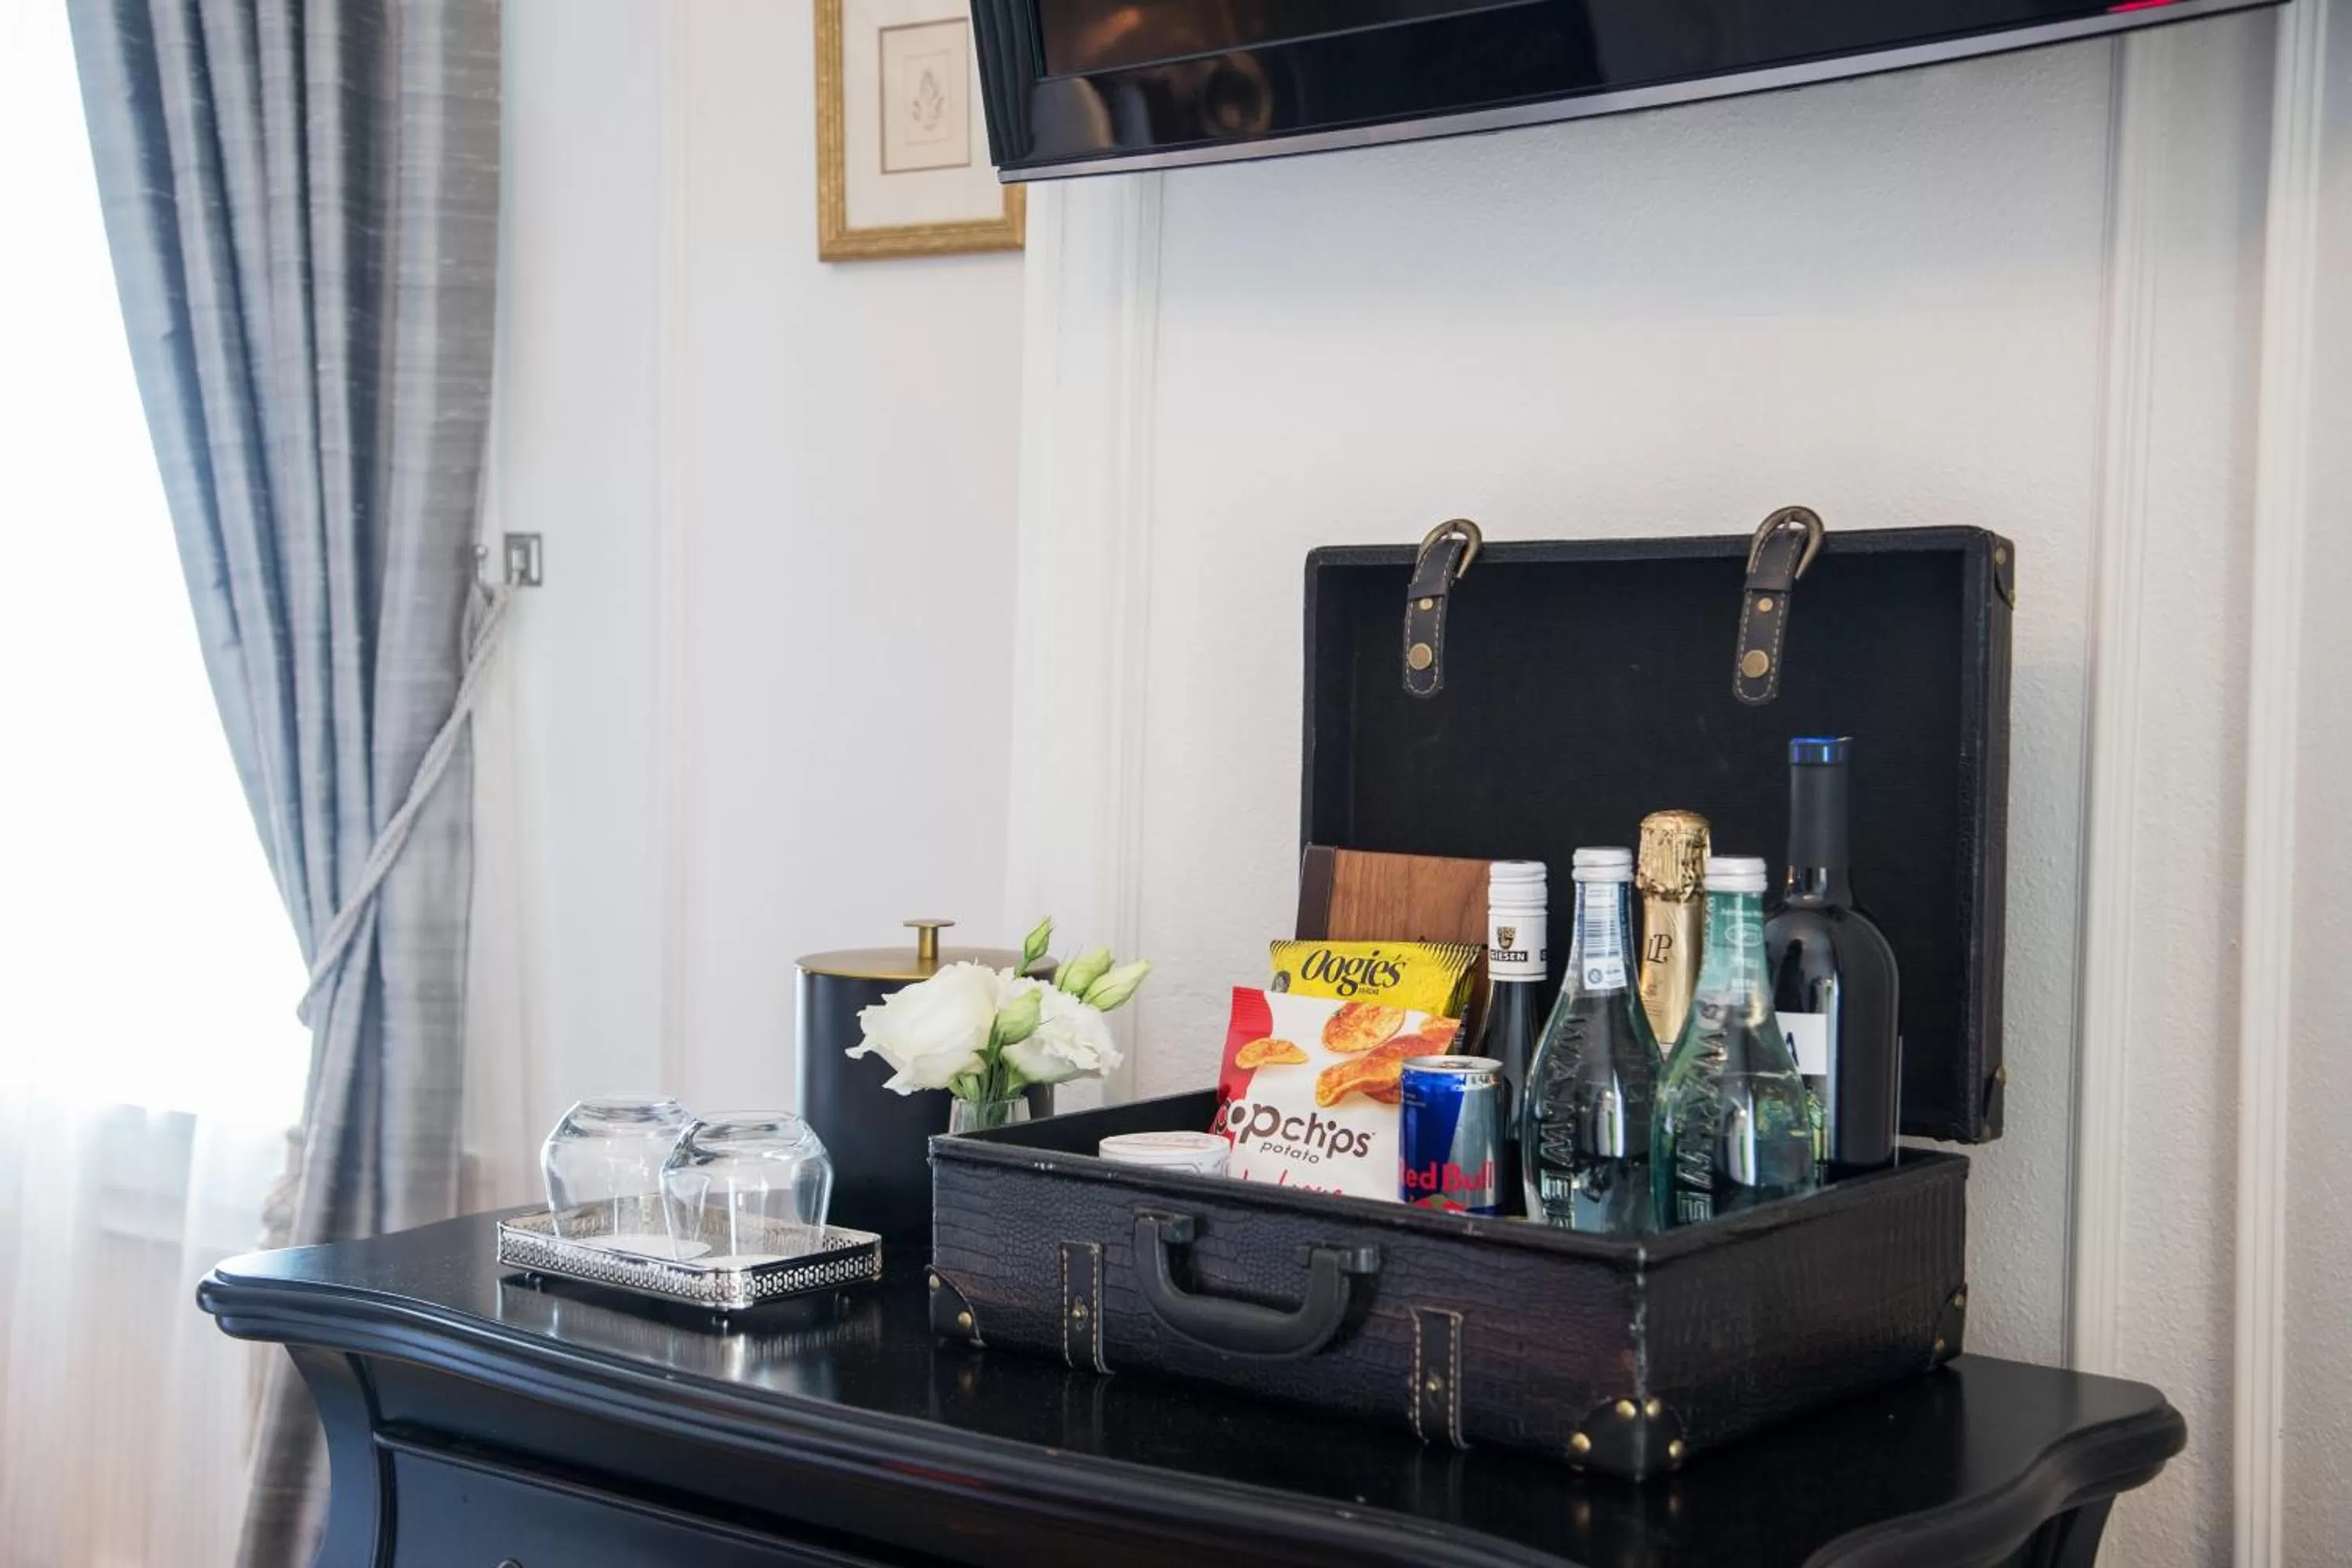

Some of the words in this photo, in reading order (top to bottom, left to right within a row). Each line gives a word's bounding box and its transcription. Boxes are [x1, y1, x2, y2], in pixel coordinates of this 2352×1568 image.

[1260, 1141, 1320, 1165] potato
[1399, 1160, 1437, 1190] ed
[1442, 1160, 1494, 1192] Bull
